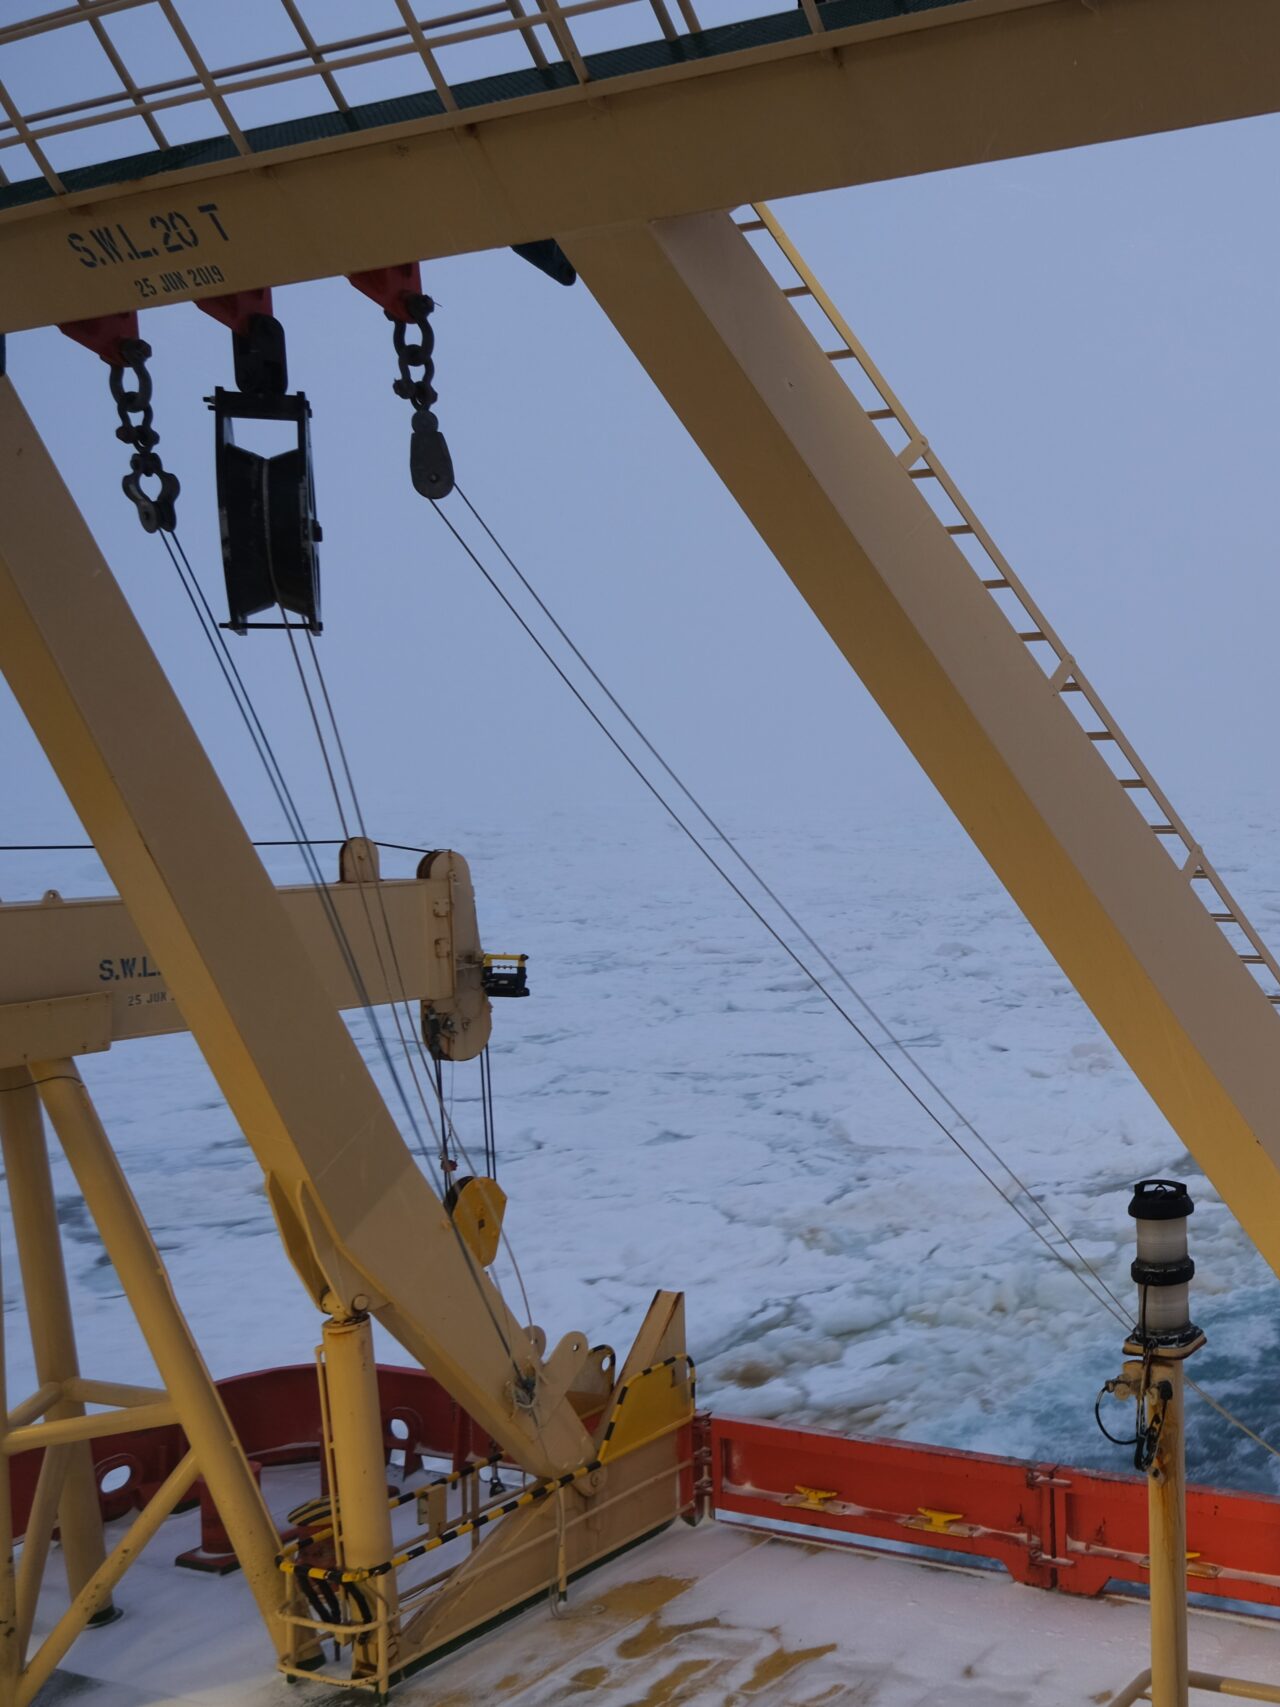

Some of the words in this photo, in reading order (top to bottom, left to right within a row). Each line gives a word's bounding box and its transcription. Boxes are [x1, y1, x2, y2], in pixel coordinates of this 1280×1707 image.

[197, 203, 229, 241] T
[134, 277, 157, 297] 25
[159, 271, 189, 293] JUN
[187, 265, 225, 286] 2019
[99, 956, 161, 981] S.W.L.
[127, 994, 142, 1007] 25
